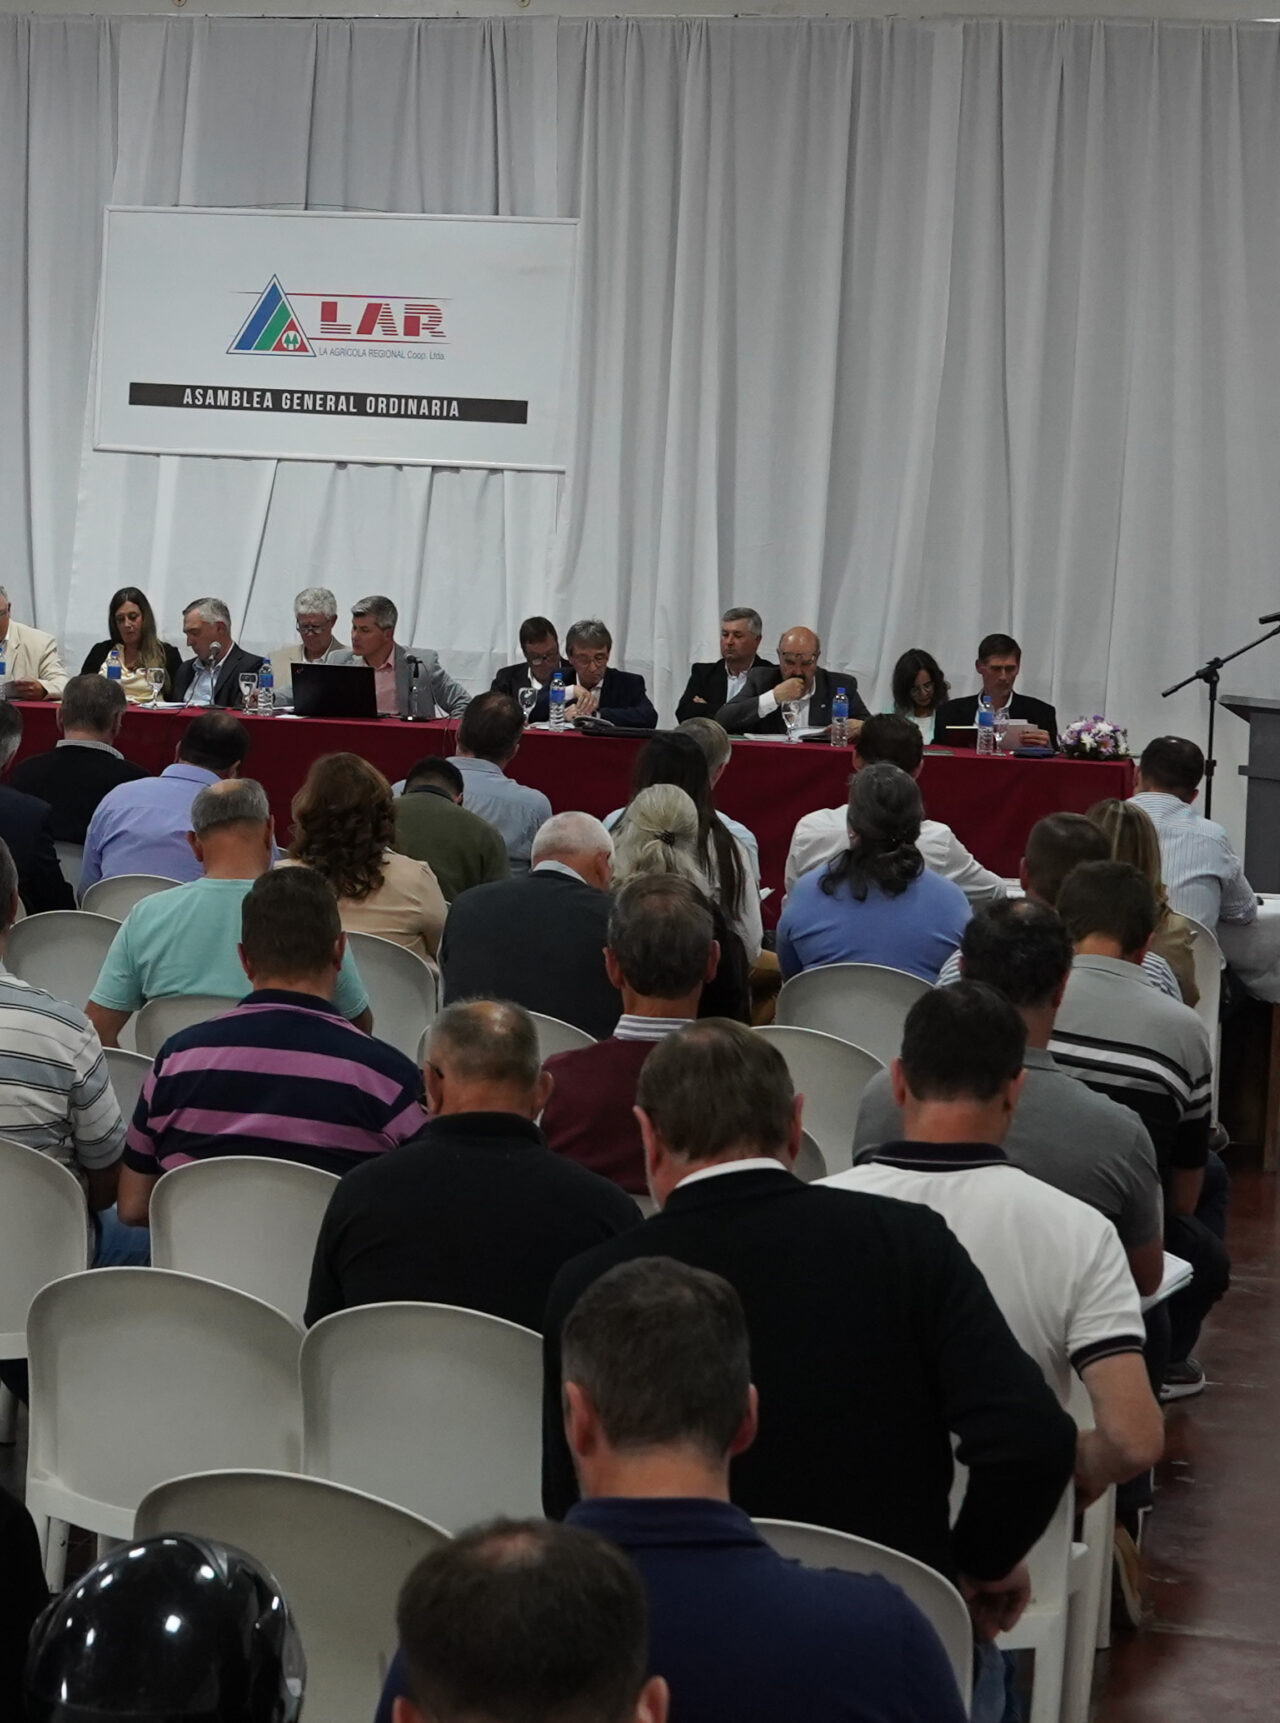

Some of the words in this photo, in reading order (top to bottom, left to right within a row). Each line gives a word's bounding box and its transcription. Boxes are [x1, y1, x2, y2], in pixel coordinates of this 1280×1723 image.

[320, 301, 447, 338] LAR
[368, 349, 405, 359] REGIONAL
[182, 387, 274, 410] ASAMBLEA
[281, 392, 358, 414] GENERAL
[366, 397, 460, 418] ORDINARIA
